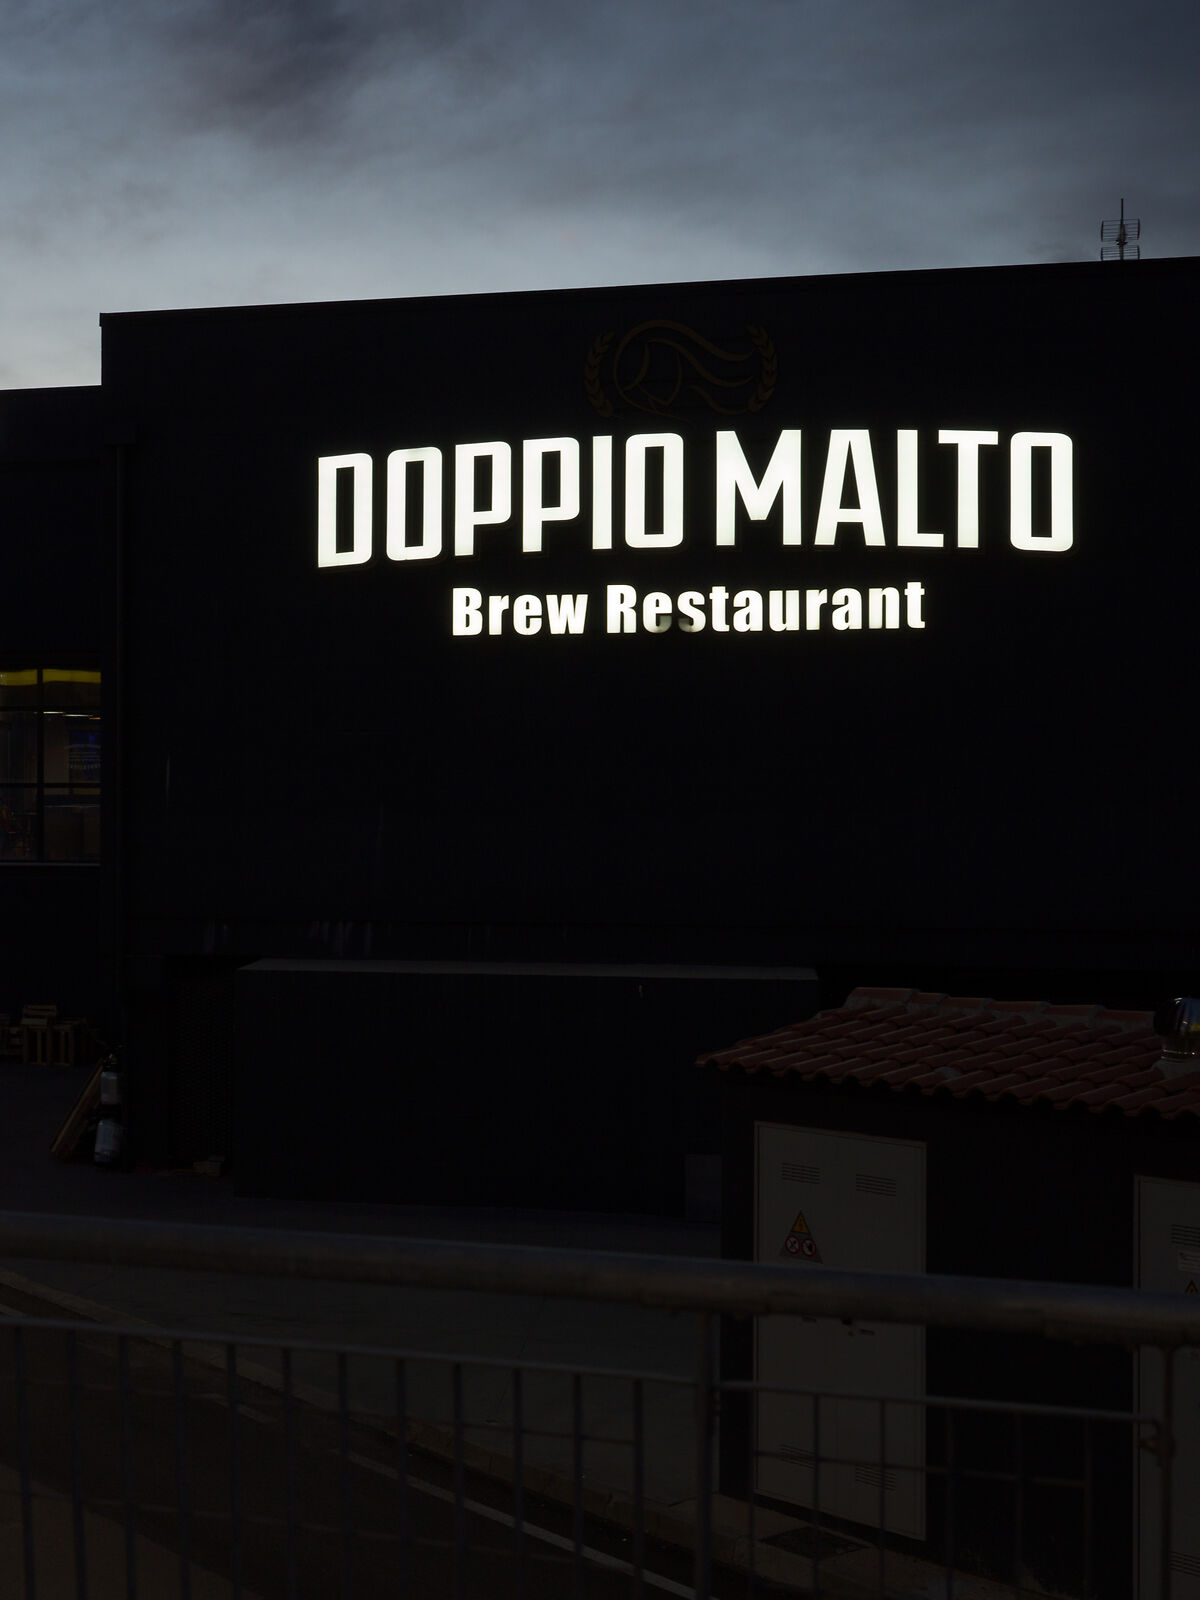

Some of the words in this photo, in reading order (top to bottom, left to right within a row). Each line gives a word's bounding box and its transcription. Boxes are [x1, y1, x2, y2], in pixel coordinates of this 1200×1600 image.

[317, 432, 684, 568] DOPPIO
[715, 429, 1074, 552] MALTO
[452, 587, 589, 636] Brew
[606, 581, 926, 634] Restaurant
